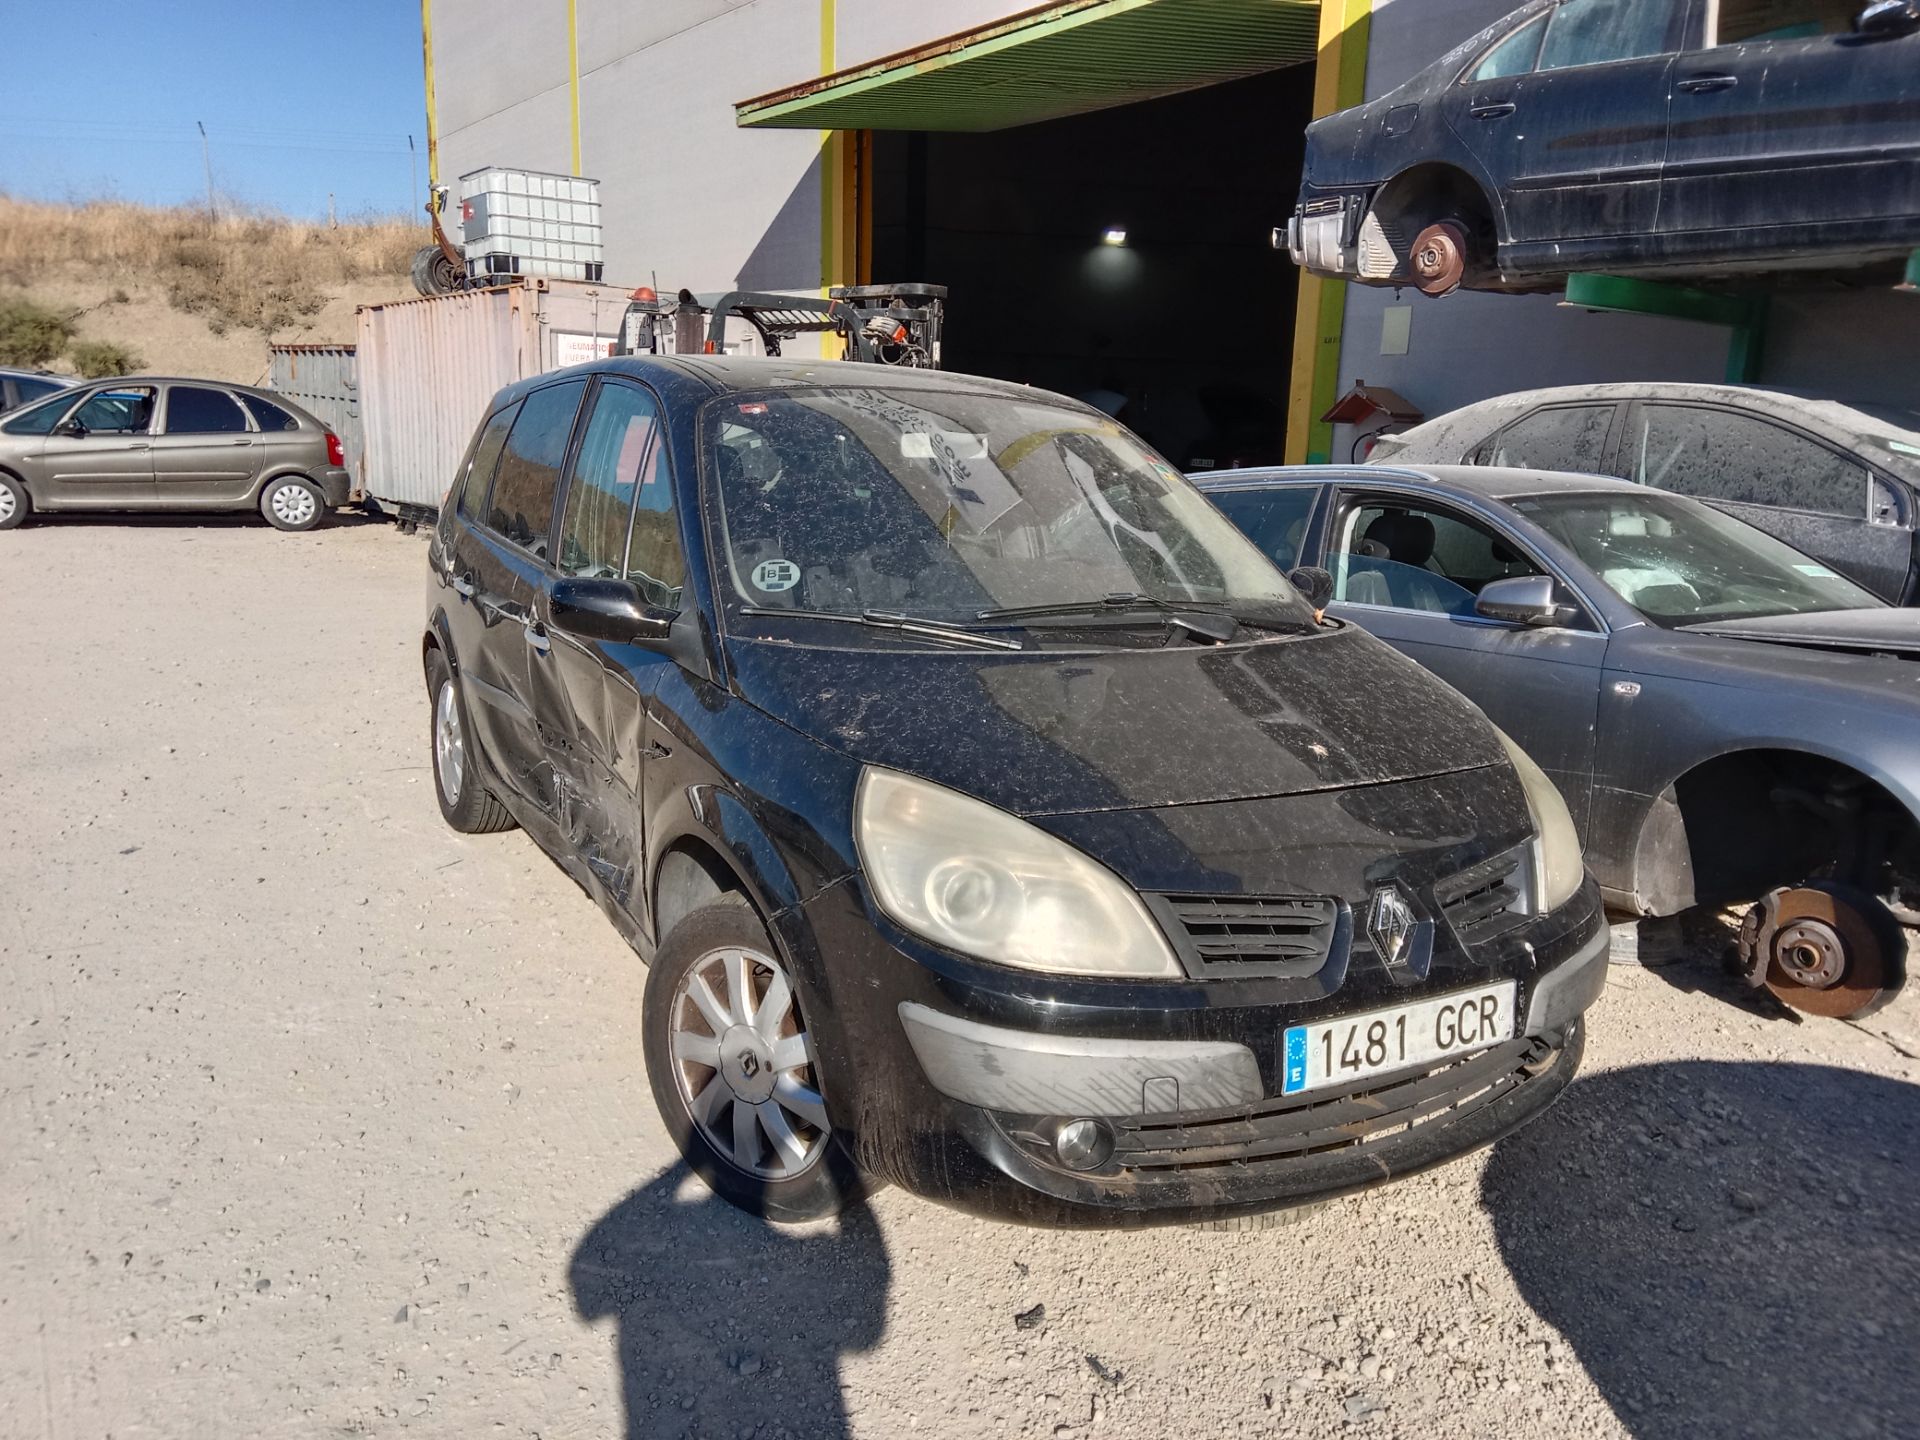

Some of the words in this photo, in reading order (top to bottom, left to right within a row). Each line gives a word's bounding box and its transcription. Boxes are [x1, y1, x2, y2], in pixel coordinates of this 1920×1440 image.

[1291, 1066, 1302, 1082] E
[1321, 1014, 1407, 1078] 1481
[1435, 994, 1499, 1050] GCR
